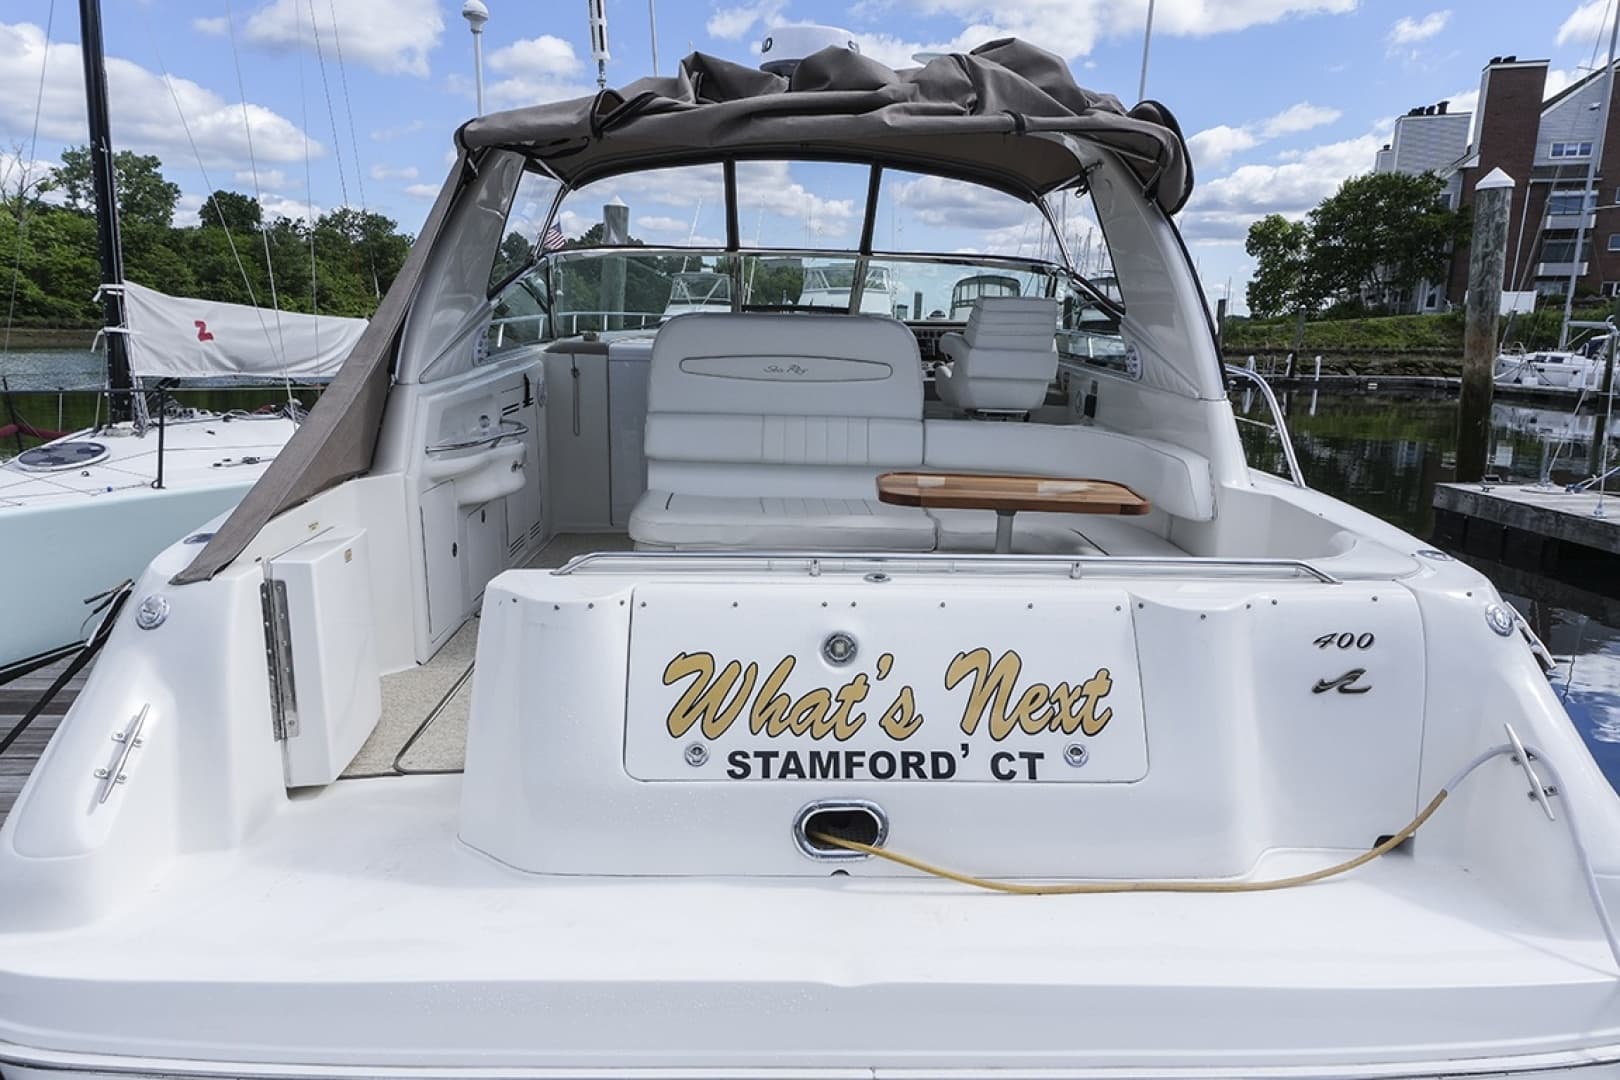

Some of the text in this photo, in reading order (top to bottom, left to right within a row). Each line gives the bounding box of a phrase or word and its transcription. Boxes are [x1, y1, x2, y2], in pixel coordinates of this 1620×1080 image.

[1312, 632, 1375, 649] 400
[662, 647, 1113, 742] What's Next
[990, 751, 1045, 781] CT
